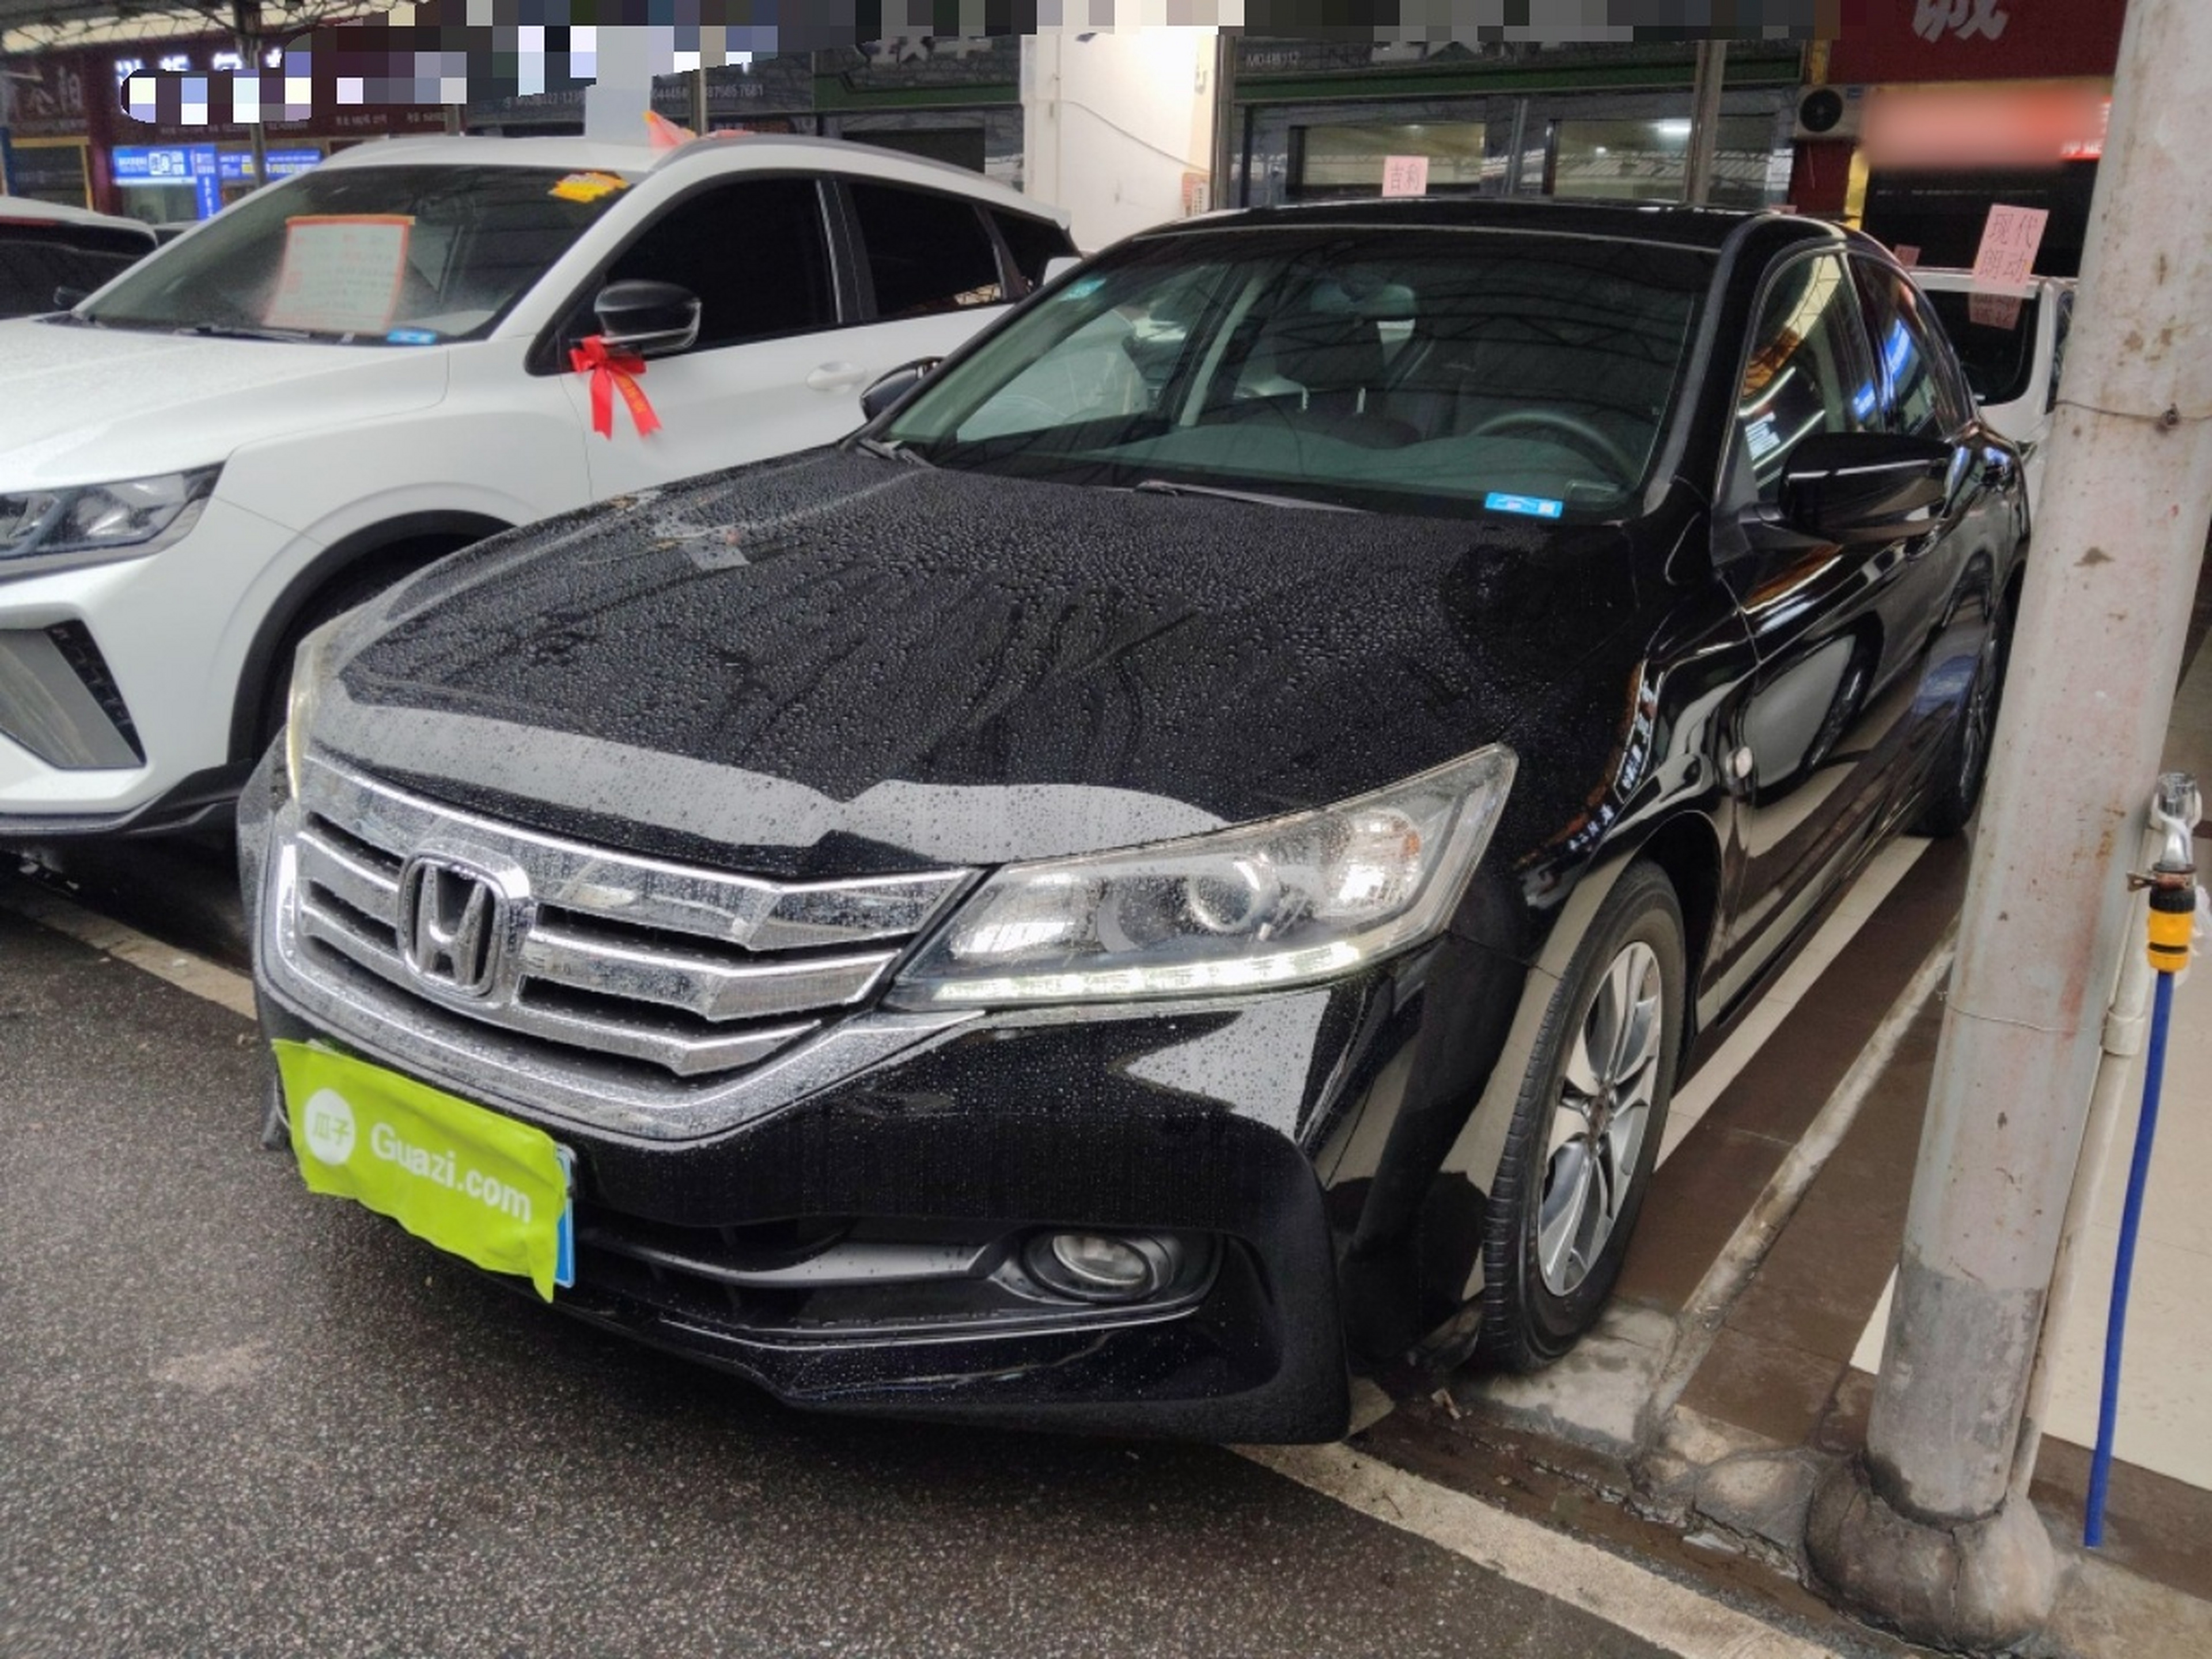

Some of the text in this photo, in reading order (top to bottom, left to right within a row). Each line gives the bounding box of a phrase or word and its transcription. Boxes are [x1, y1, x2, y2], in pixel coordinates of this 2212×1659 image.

[1987, 213, 2038, 249] 现代
[313, 1111, 350, 1147] 瓜子
[370, 1122, 531, 1224] Guazi.com
